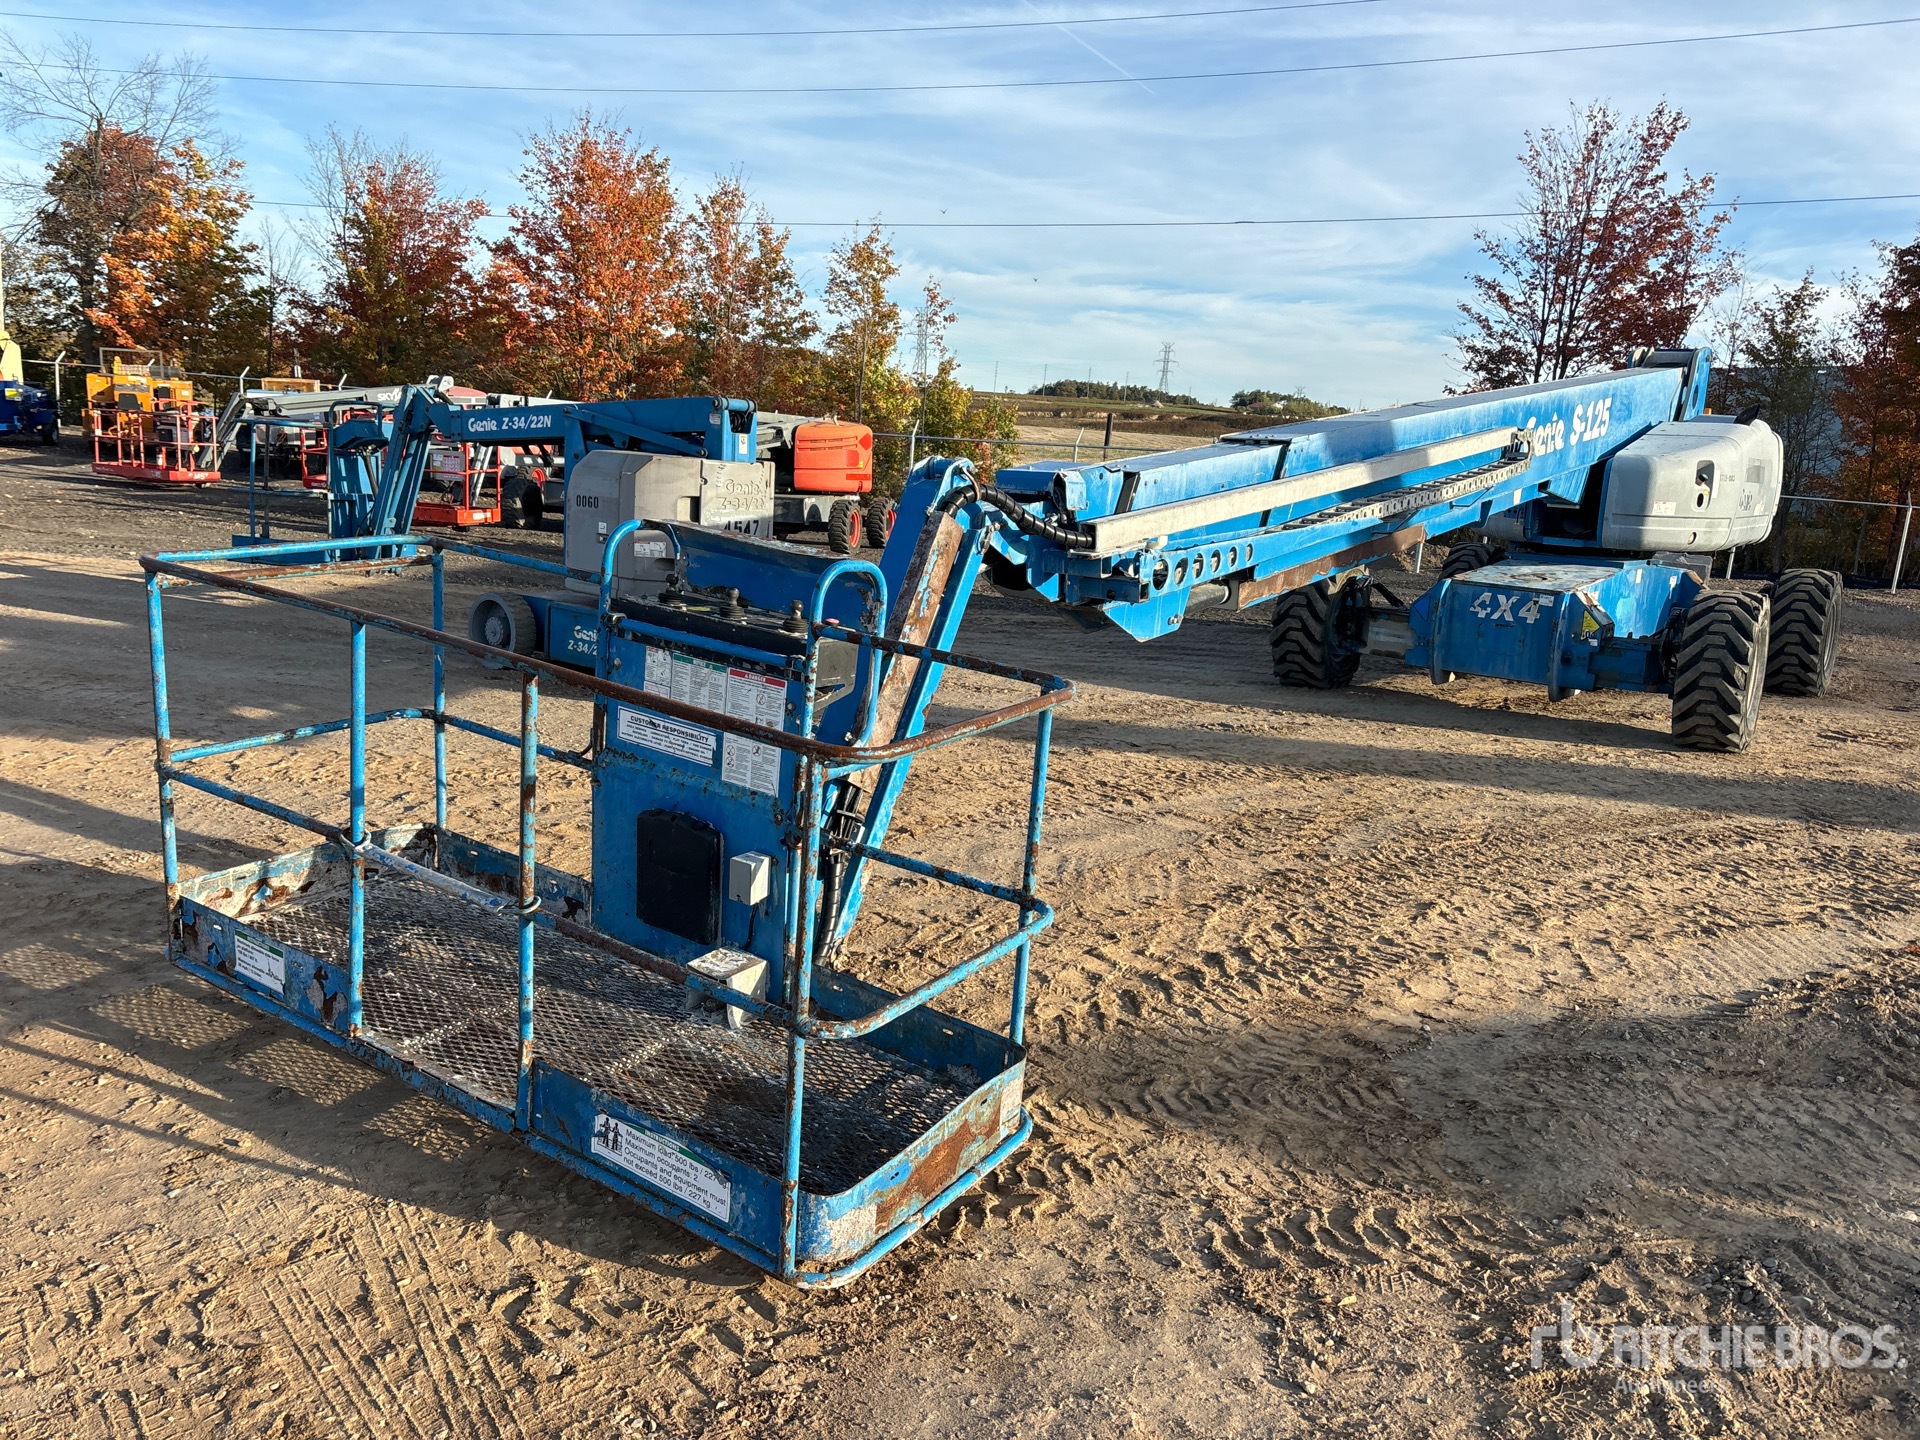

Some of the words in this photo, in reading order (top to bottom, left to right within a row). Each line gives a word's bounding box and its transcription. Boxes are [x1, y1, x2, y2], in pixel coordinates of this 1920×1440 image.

[377, 387, 402, 401] SKYJ
[468, 417, 499, 432] Genie
[502, 414, 551, 430] Z-34/22N
[1570, 397, 1613, 447] S-125
[725, 478, 762, 495] Genie
[576, 494, 599, 509] 0060
[716, 496, 765, 511] Z-34/22
[724, 519, 759, 536] 4547
[1470, 592, 1541, 624] 4X4
[573, 625, 598, 642] Geni
[567, 639, 598, 656] Z-34/2
[630, 715, 661, 729] CUSTOMER
[662, 724, 709, 743] RESPONSIBILITY
[625, 1137, 656, 1160] Maximum
[656, 1155, 692, 1179] occupants:
[626, 1129, 657, 1151] Maximum
[674, 1154, 688, 1167] 500
[688, 1161, 699, 1173] lbs
[624, 1146, 658, 1171] Occupants
[659, 1166, 673, 1178] and
[673, 1171, 709, 1197] equipment
[709, 1189, 727, 1206] must
[624, 1156, 635, 1168] not
[635, 1161, 658, 1180] exceed
[658, 1174, 672, 1187] 500
[672, 1179, 683, 1194] lbs
[688, 1188, 701, 1201] 227
